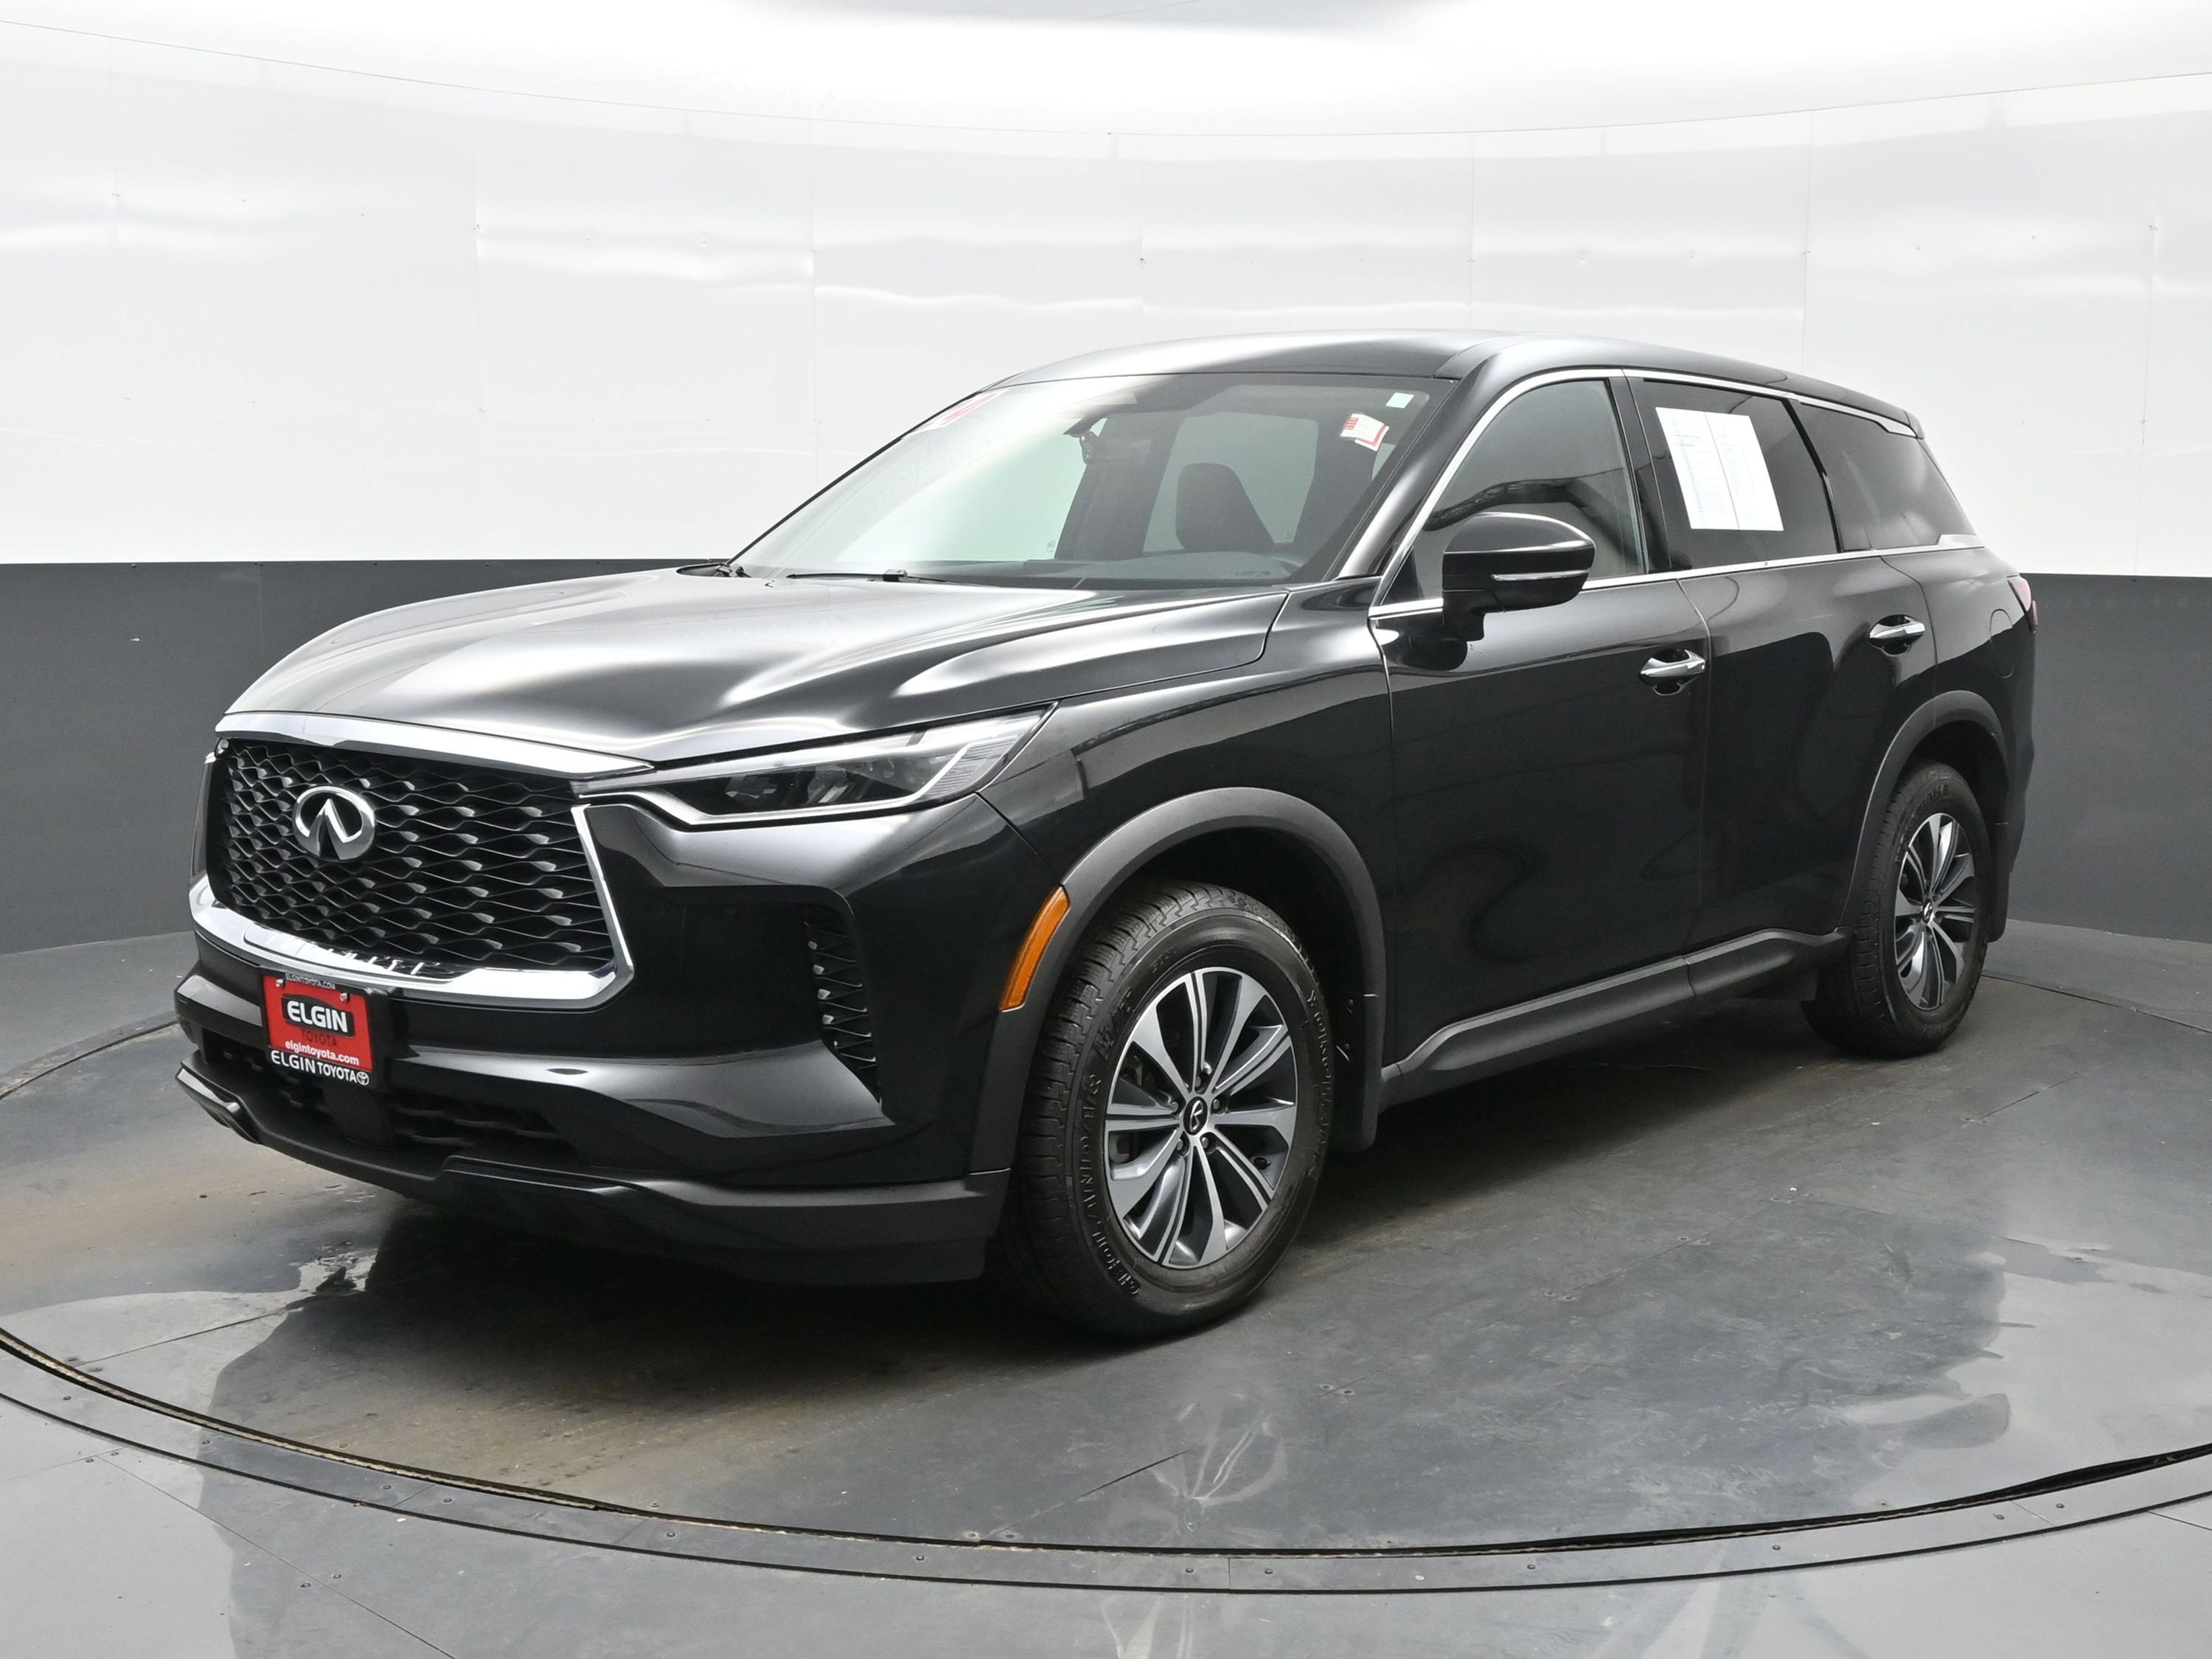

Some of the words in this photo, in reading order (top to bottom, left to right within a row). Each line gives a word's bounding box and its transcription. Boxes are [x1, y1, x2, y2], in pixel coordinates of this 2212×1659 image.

[285, 973, 336, 990] ELGINTOYOTA.COM
[287, 1001, 348, 1032] ELGIN
[299, 1029, 337, 1046] TOYOTA
[285, 1040, 360, 1065] elgintoyota.com
[271, 1050, 316, 1074] ELGIN
[317, 1062, 358, 1083] TOYOTA
